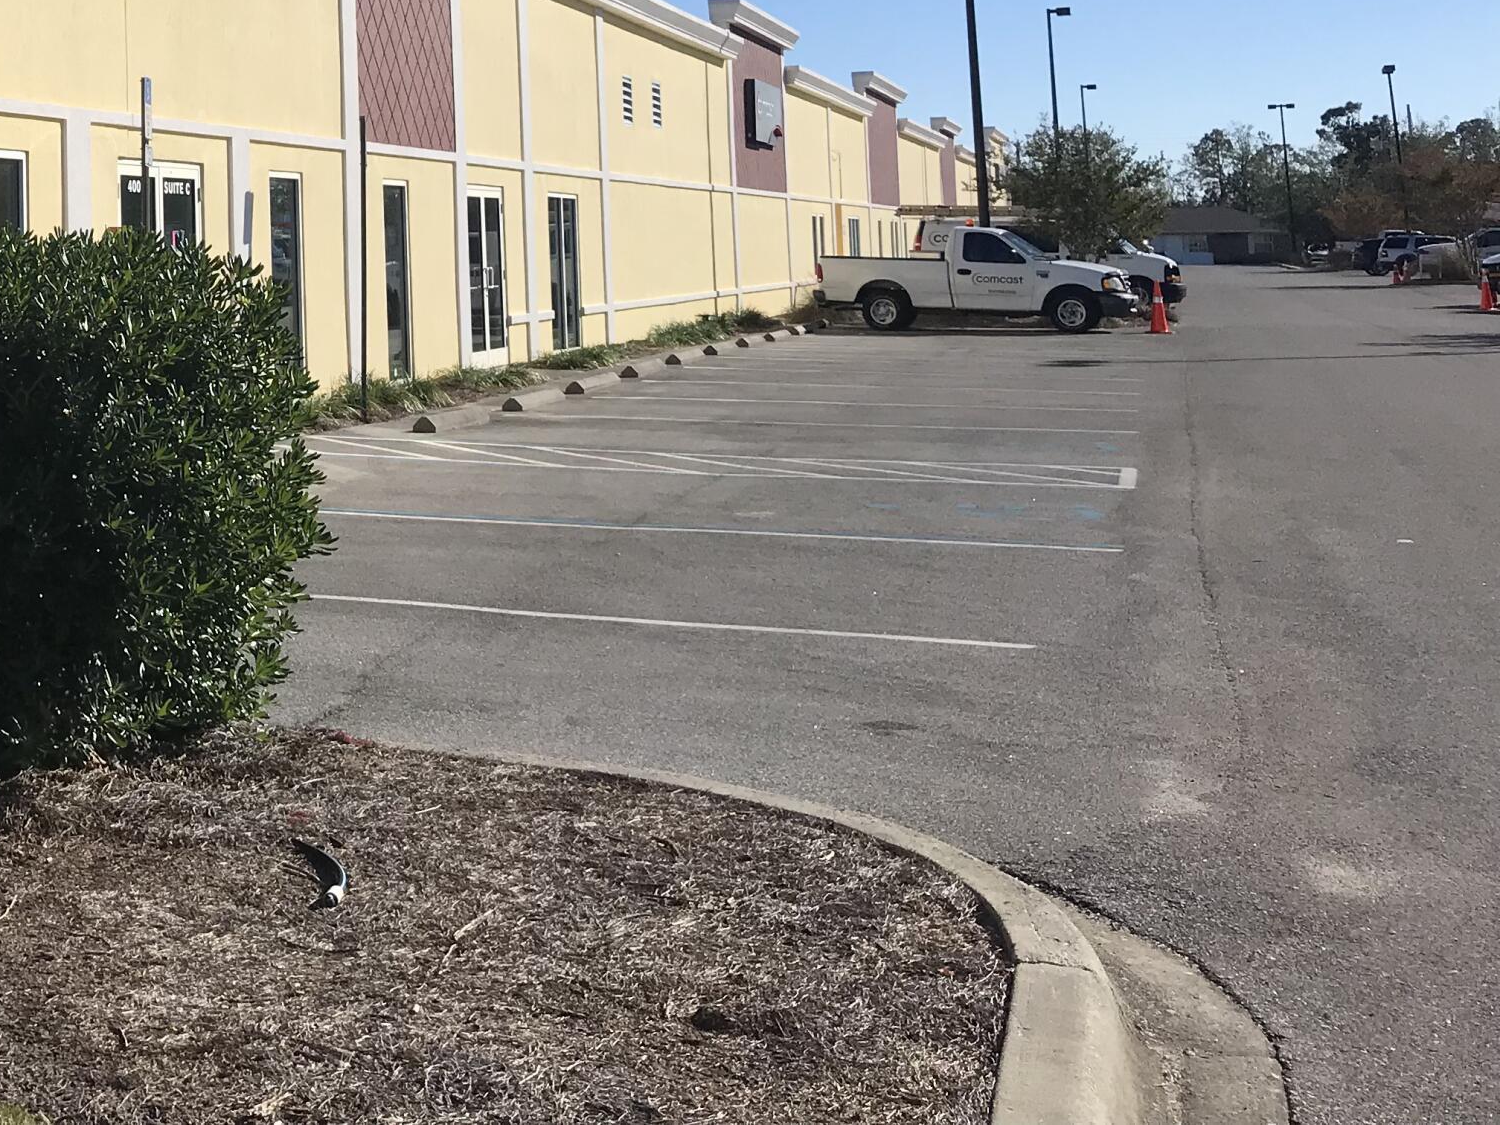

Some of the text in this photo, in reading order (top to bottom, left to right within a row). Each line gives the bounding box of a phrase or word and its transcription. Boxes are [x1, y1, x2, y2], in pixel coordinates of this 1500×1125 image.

[127, 179, 142, 194] 400
[163, 181, 191, 196] SUITE C
